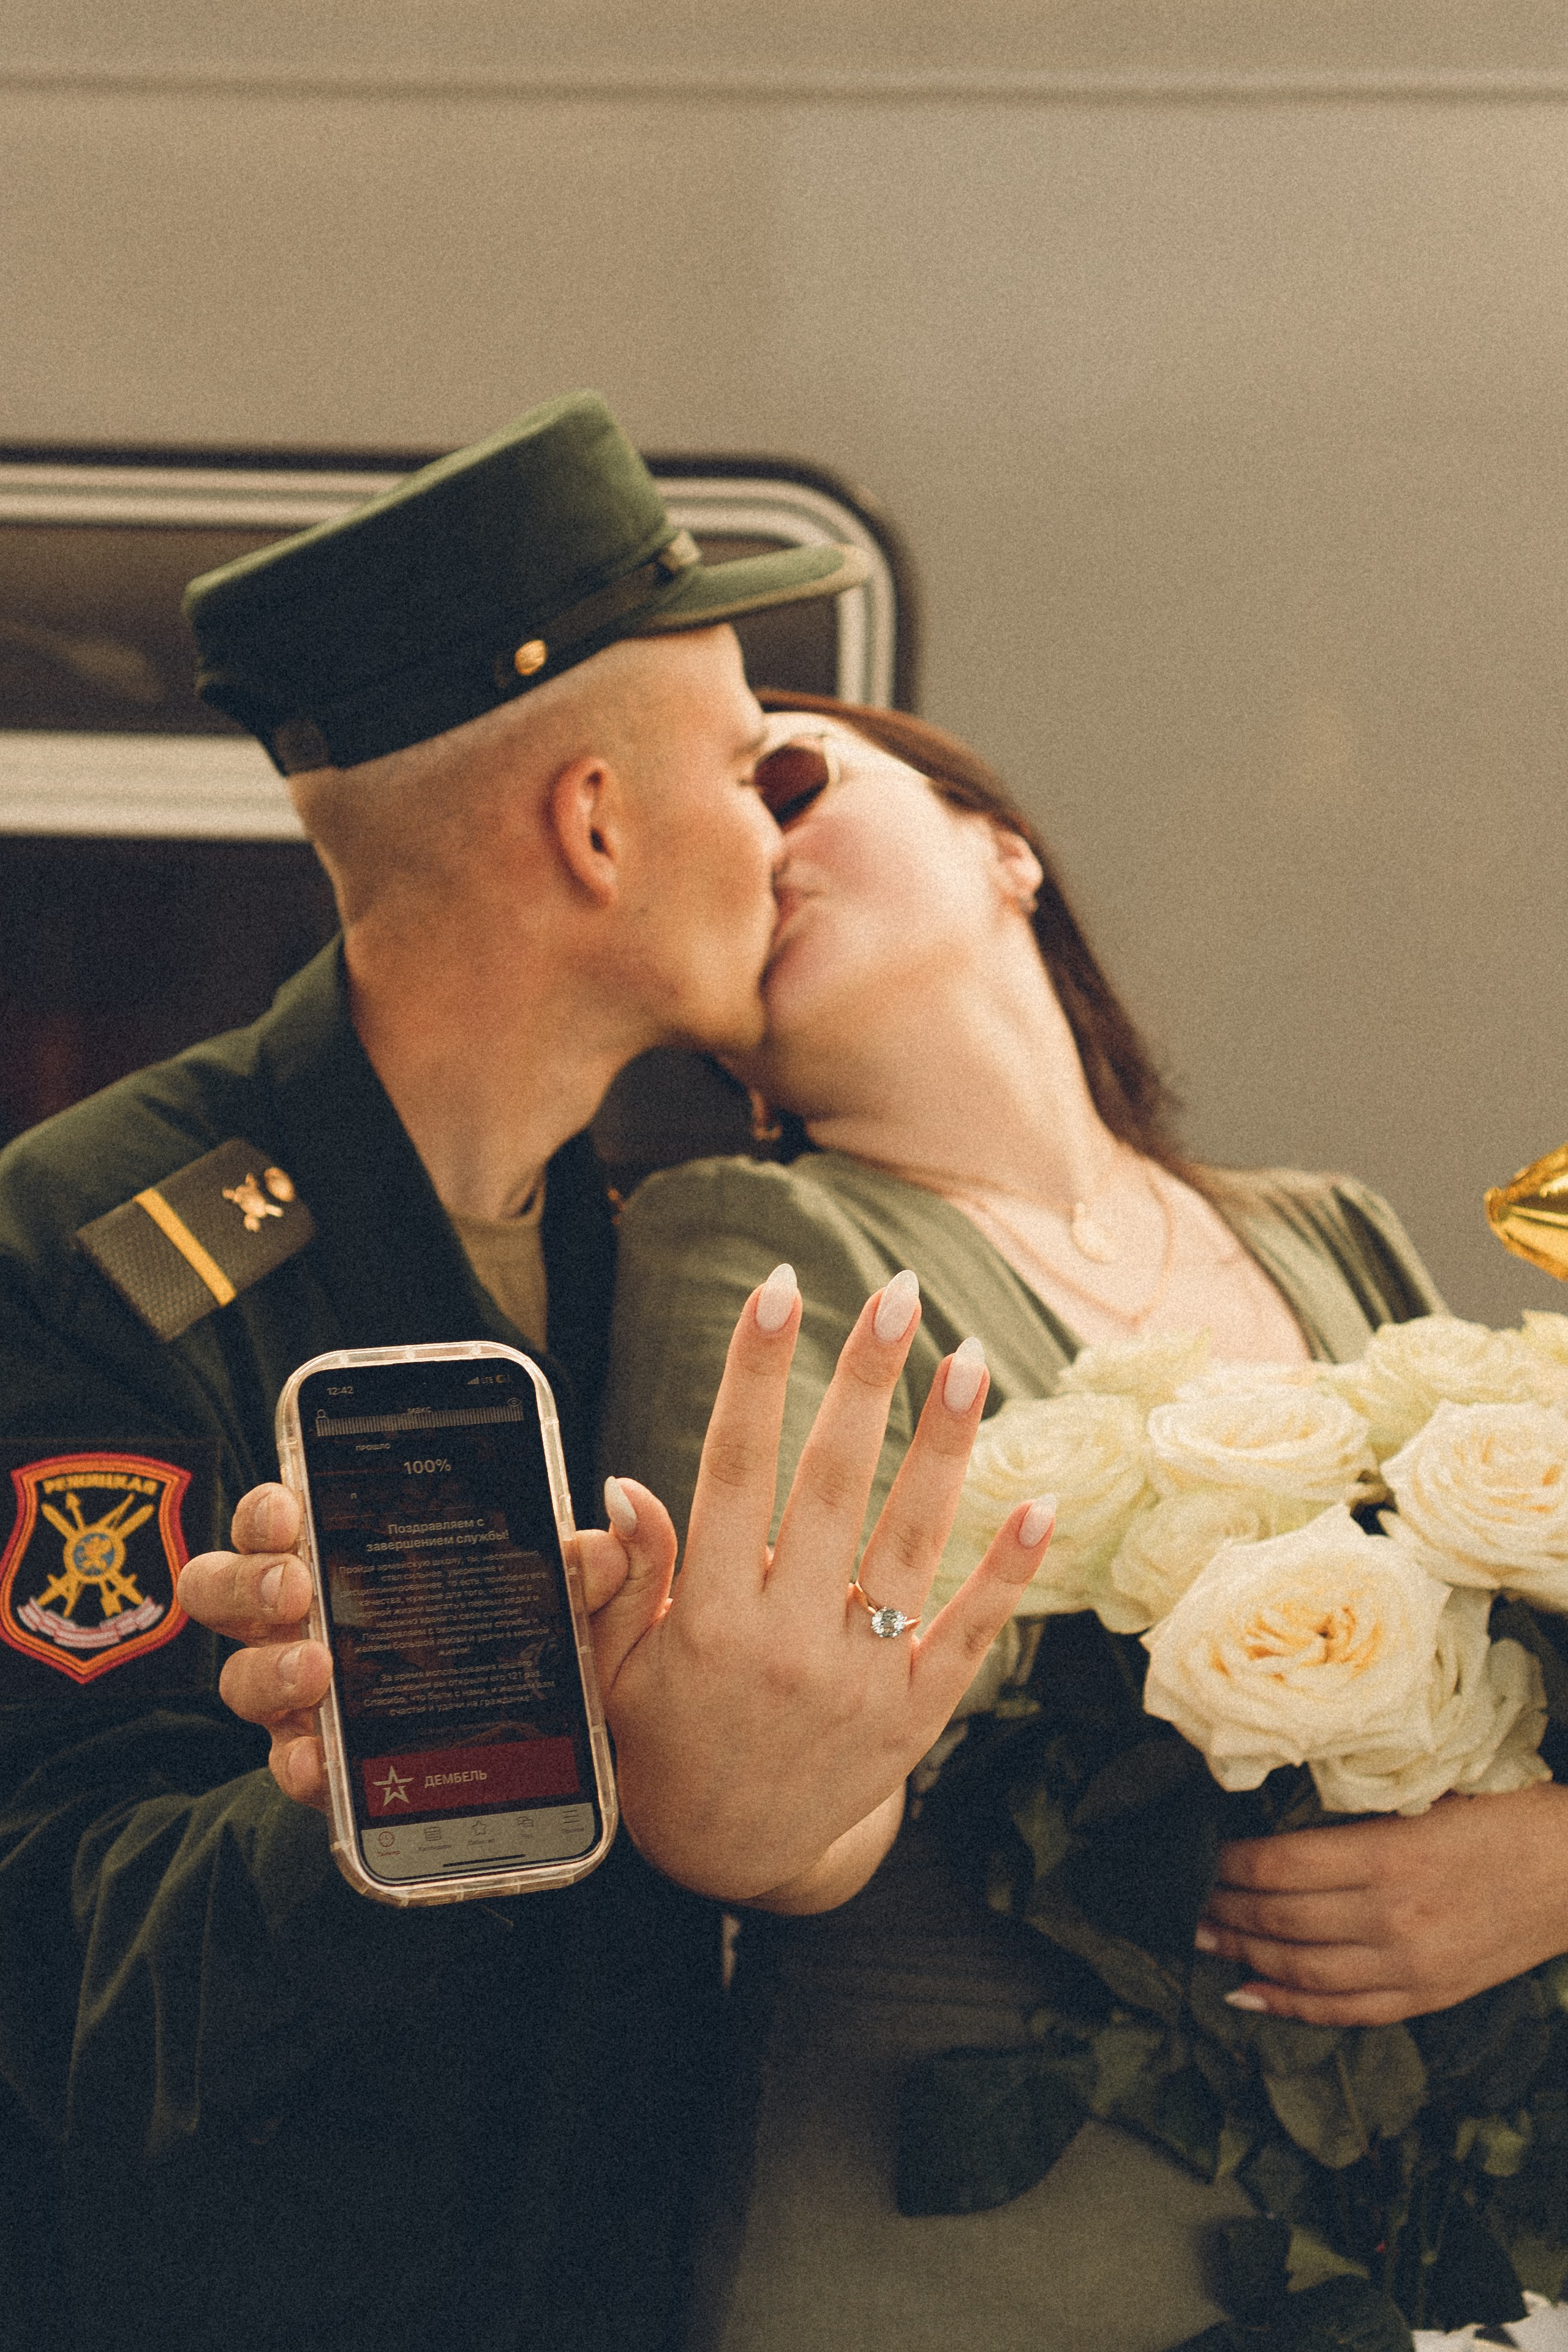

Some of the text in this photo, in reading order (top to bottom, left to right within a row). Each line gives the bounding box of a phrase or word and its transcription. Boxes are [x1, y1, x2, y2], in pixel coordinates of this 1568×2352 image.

[327, 1386, 353, 1395] 12:42
[355, 1443, 391, 1452] прошло
[404, 1458, 451, 1475] 100%
[388, 1519, 474, 1534] Поздравляем
[366, 1529, 510, 1551] завершением службы!
[424, 1770, 488, 1789] ДЕМБЕЛЬ
